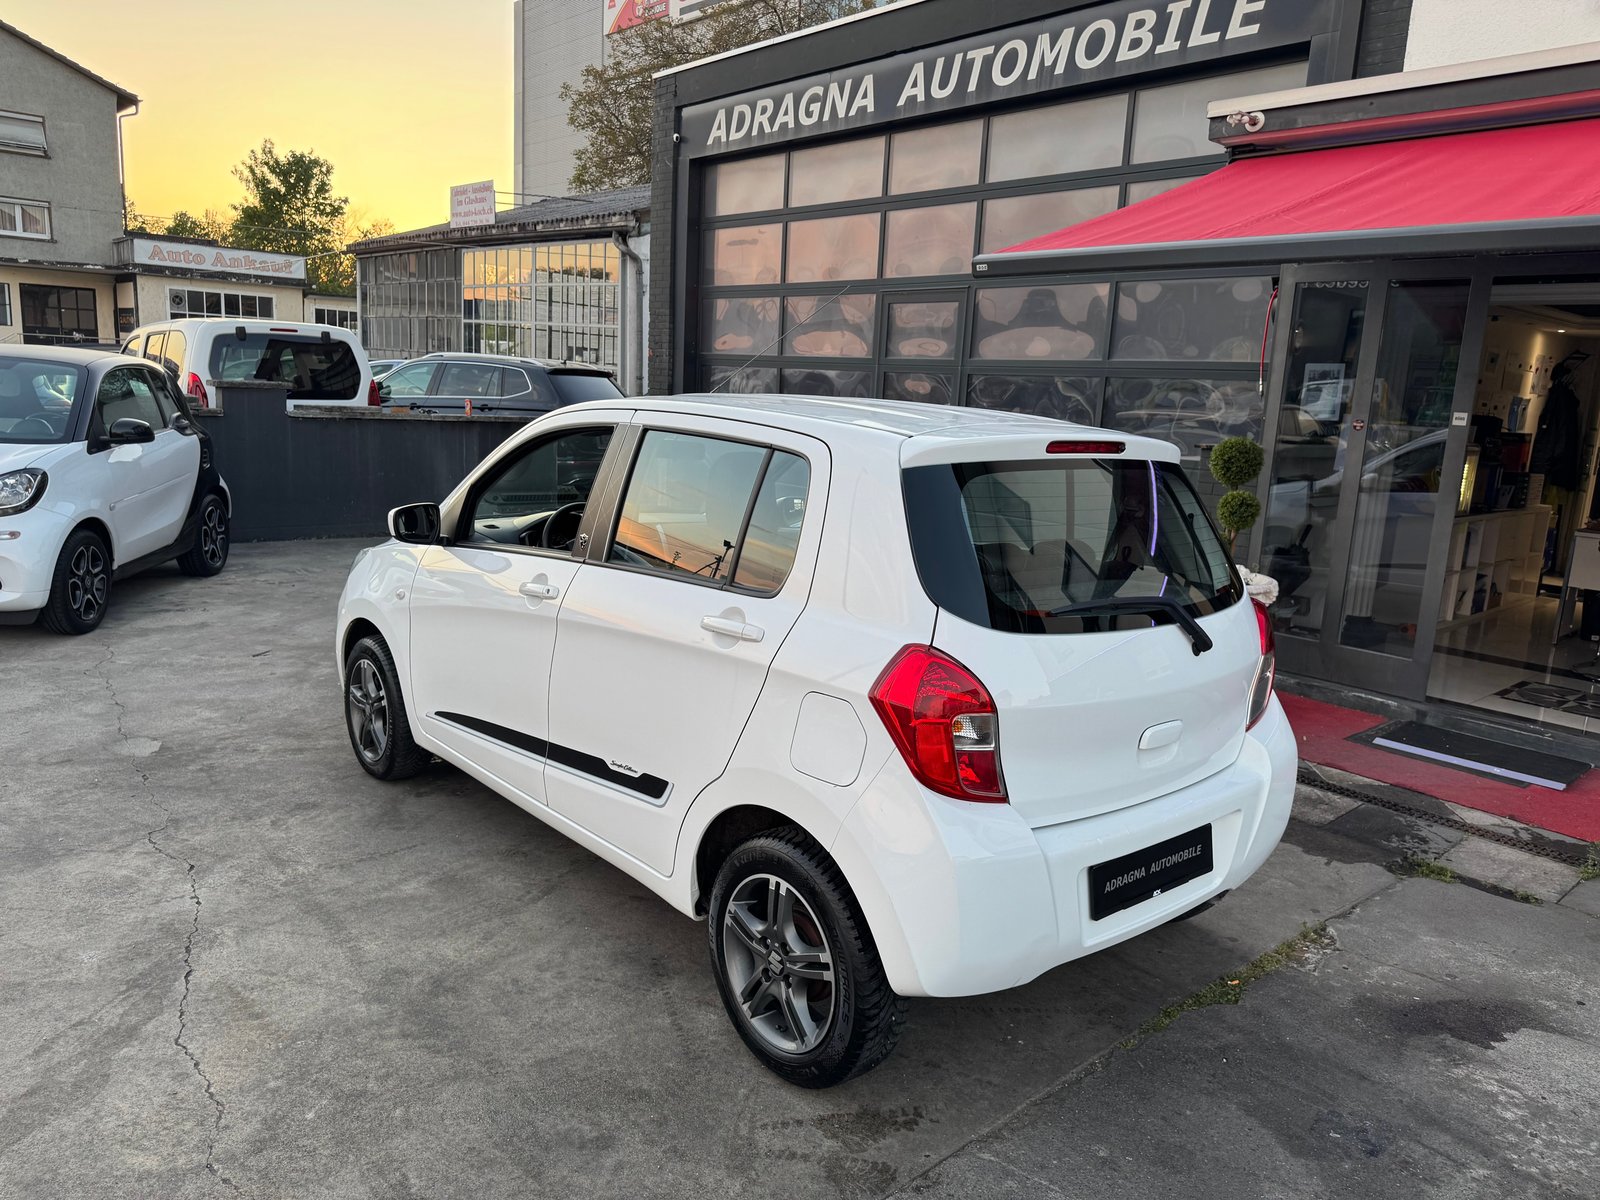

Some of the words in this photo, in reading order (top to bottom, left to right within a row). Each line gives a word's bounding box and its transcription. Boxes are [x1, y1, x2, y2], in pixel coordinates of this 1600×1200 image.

[706, 73, 875, 145] ADRAGNA
[896, 0, 1265, 107] AUTOMOBILE
[148, 244, 206, 265] Auto
[211, 251, 293, 274] Ankauf
[1103, 866, 1146, 894] ADRAGNA
[1150, 844, 1203, 874] AUTOMOBILE
